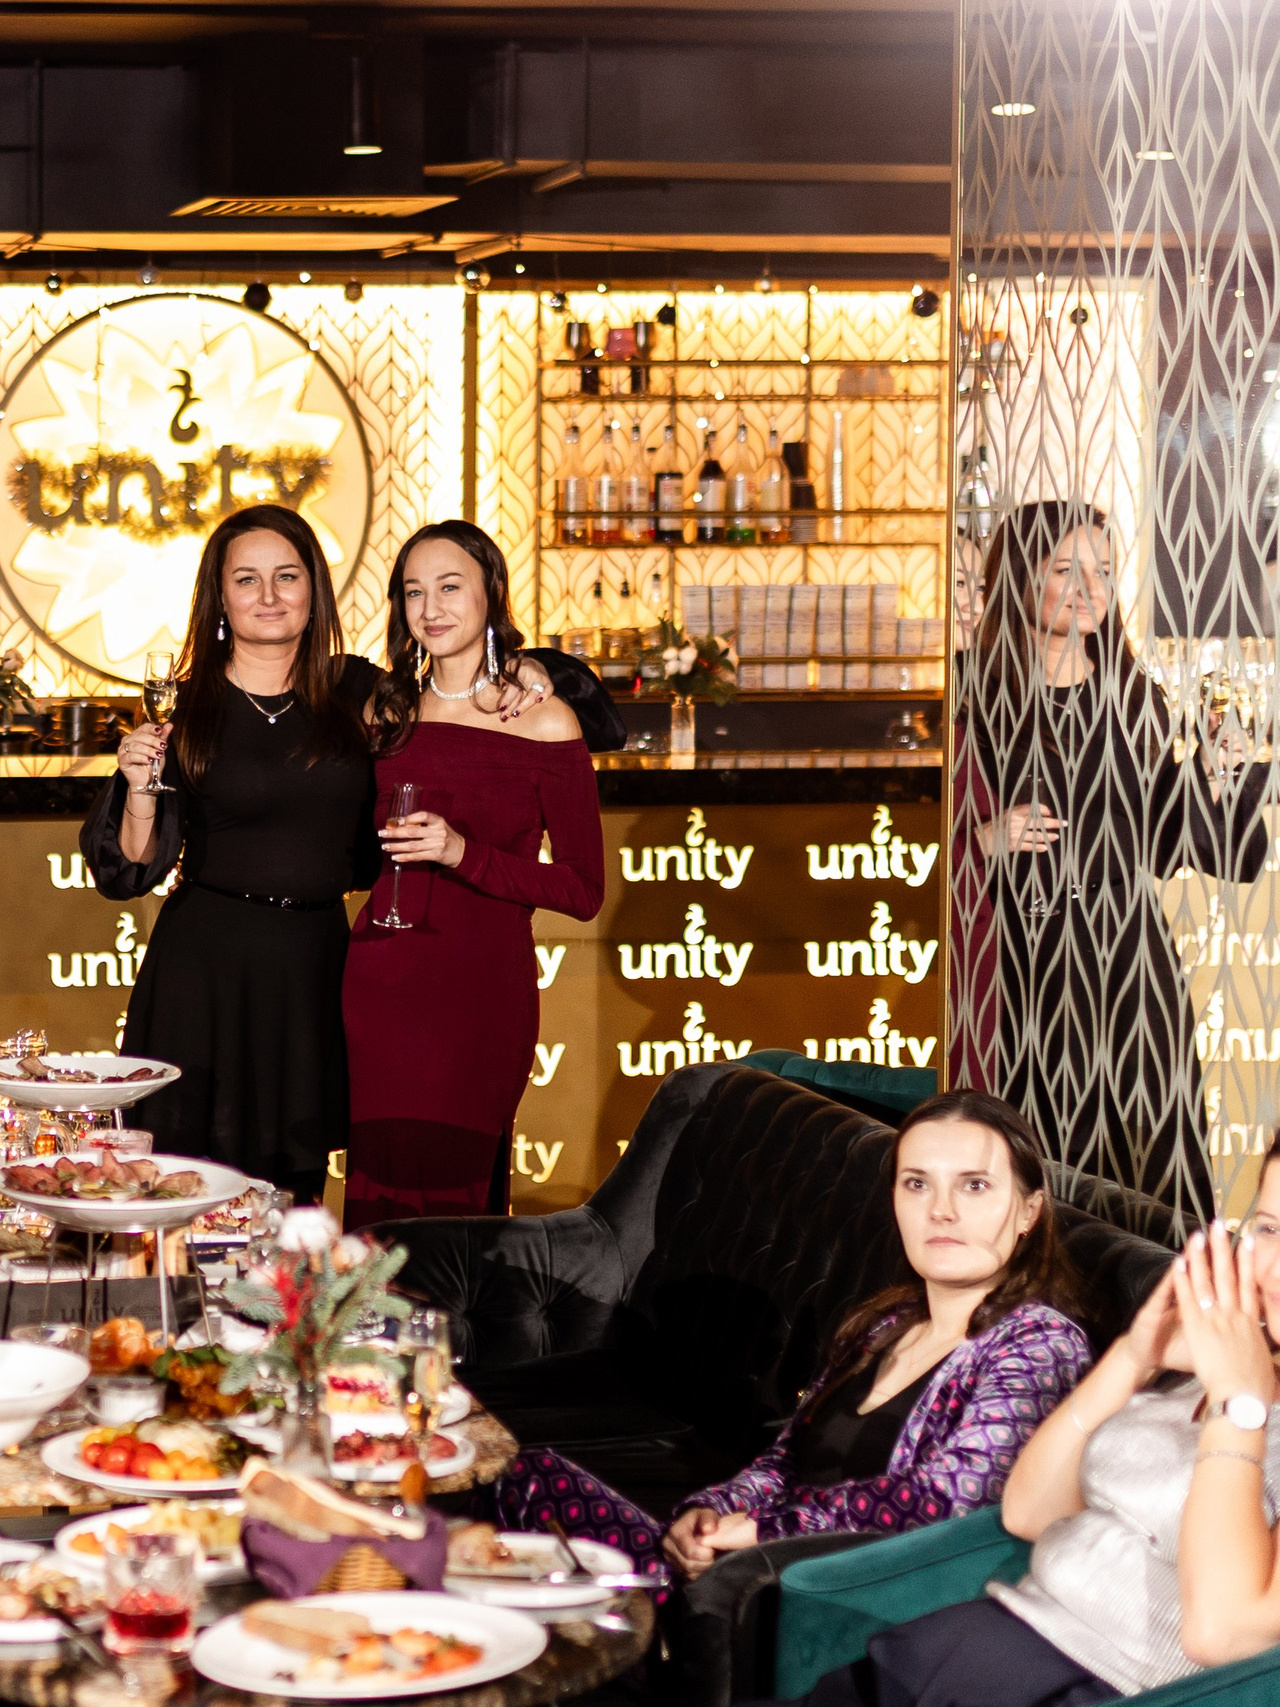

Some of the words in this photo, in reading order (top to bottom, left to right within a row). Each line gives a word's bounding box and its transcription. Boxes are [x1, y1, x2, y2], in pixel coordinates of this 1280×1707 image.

[619, 807, 754, 889] unity
[806, 804, 940, 887] unity
[618, 903, 754, 986] unity
[805, 901, 939, 984] unity
